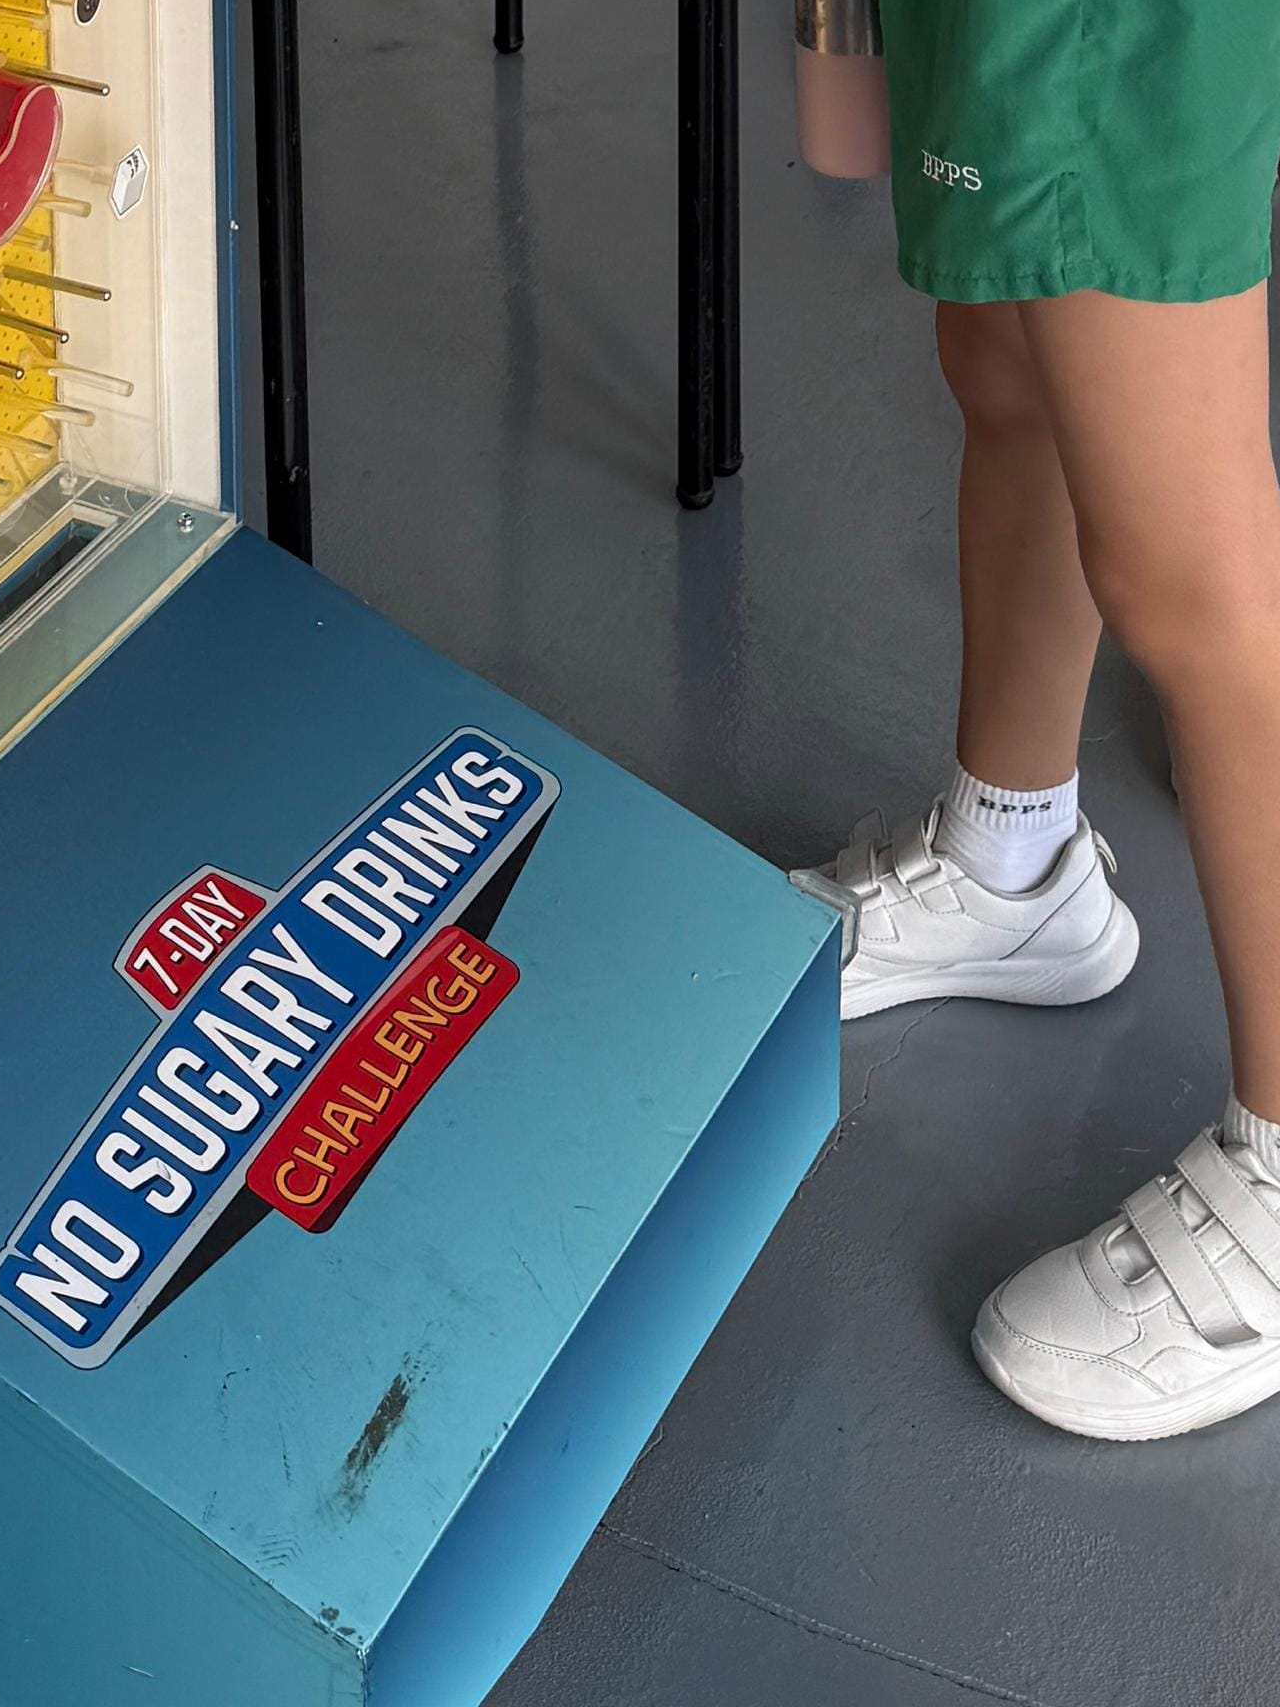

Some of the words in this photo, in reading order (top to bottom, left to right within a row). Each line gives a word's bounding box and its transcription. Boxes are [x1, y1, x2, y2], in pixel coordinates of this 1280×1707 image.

[921, 149, 982, 191] BPPS
[978, 794, 1052, 814] BPPS
[133, 880, 246, 995] 7-DAY
[15, 1199, 142, 1333] NO
[95, 922, 356, 1216] SUGARY
[301, 750, 524, 959] DRINKS
[273, 942, 497, 1205] CHALLENGE
